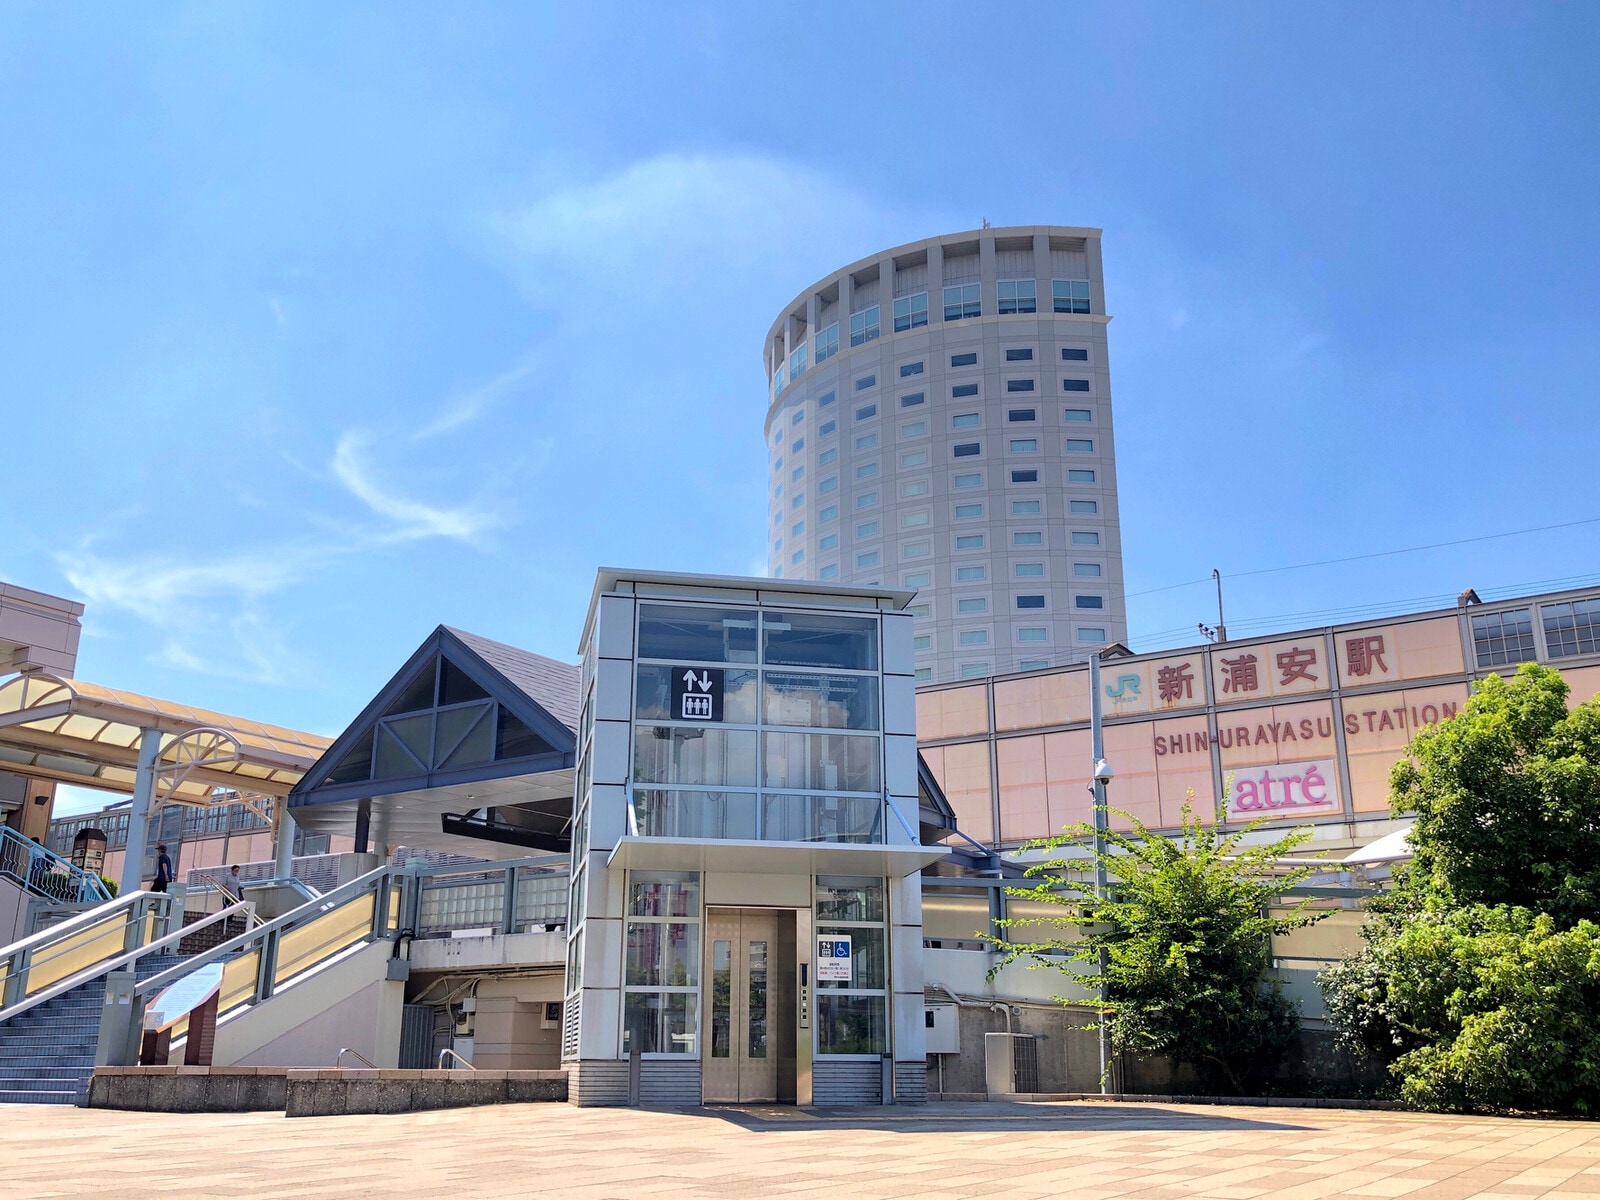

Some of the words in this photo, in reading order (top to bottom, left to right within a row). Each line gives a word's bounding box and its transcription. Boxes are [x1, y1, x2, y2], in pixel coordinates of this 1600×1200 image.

[1105, 674, 1142, 697] JR
[1157, 635, 1388, 701] 新浦安駅
[1345, 702, 1457, 734] STATION
[1236, 766, 1328, 811] atré
